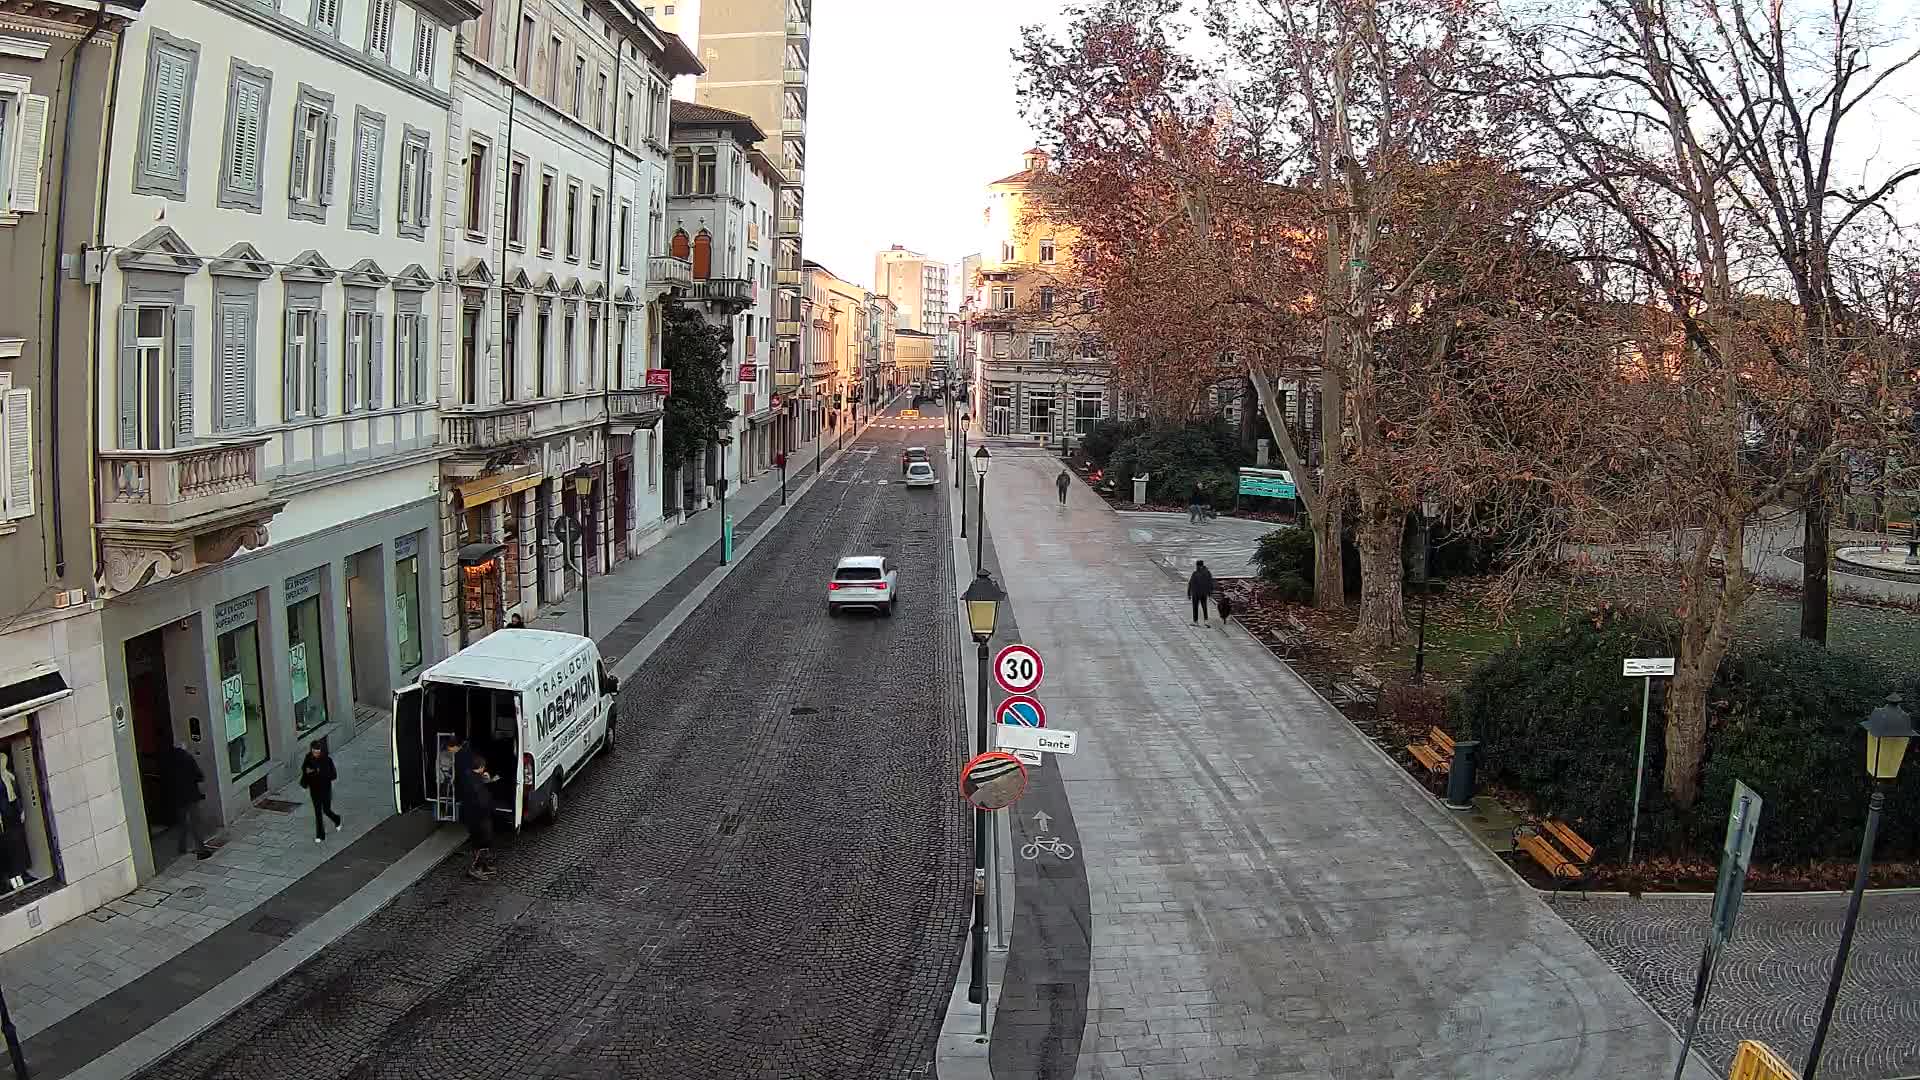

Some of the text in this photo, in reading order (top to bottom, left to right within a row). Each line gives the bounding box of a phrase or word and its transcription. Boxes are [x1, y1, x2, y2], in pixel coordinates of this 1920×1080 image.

[536, 651, 592, 700] TRASLOCHI
[1005, 658, 1033, 680] 30
[536, 669, 597, 742] MOSCHION
[1038, 738, 1070, 750] Dante
